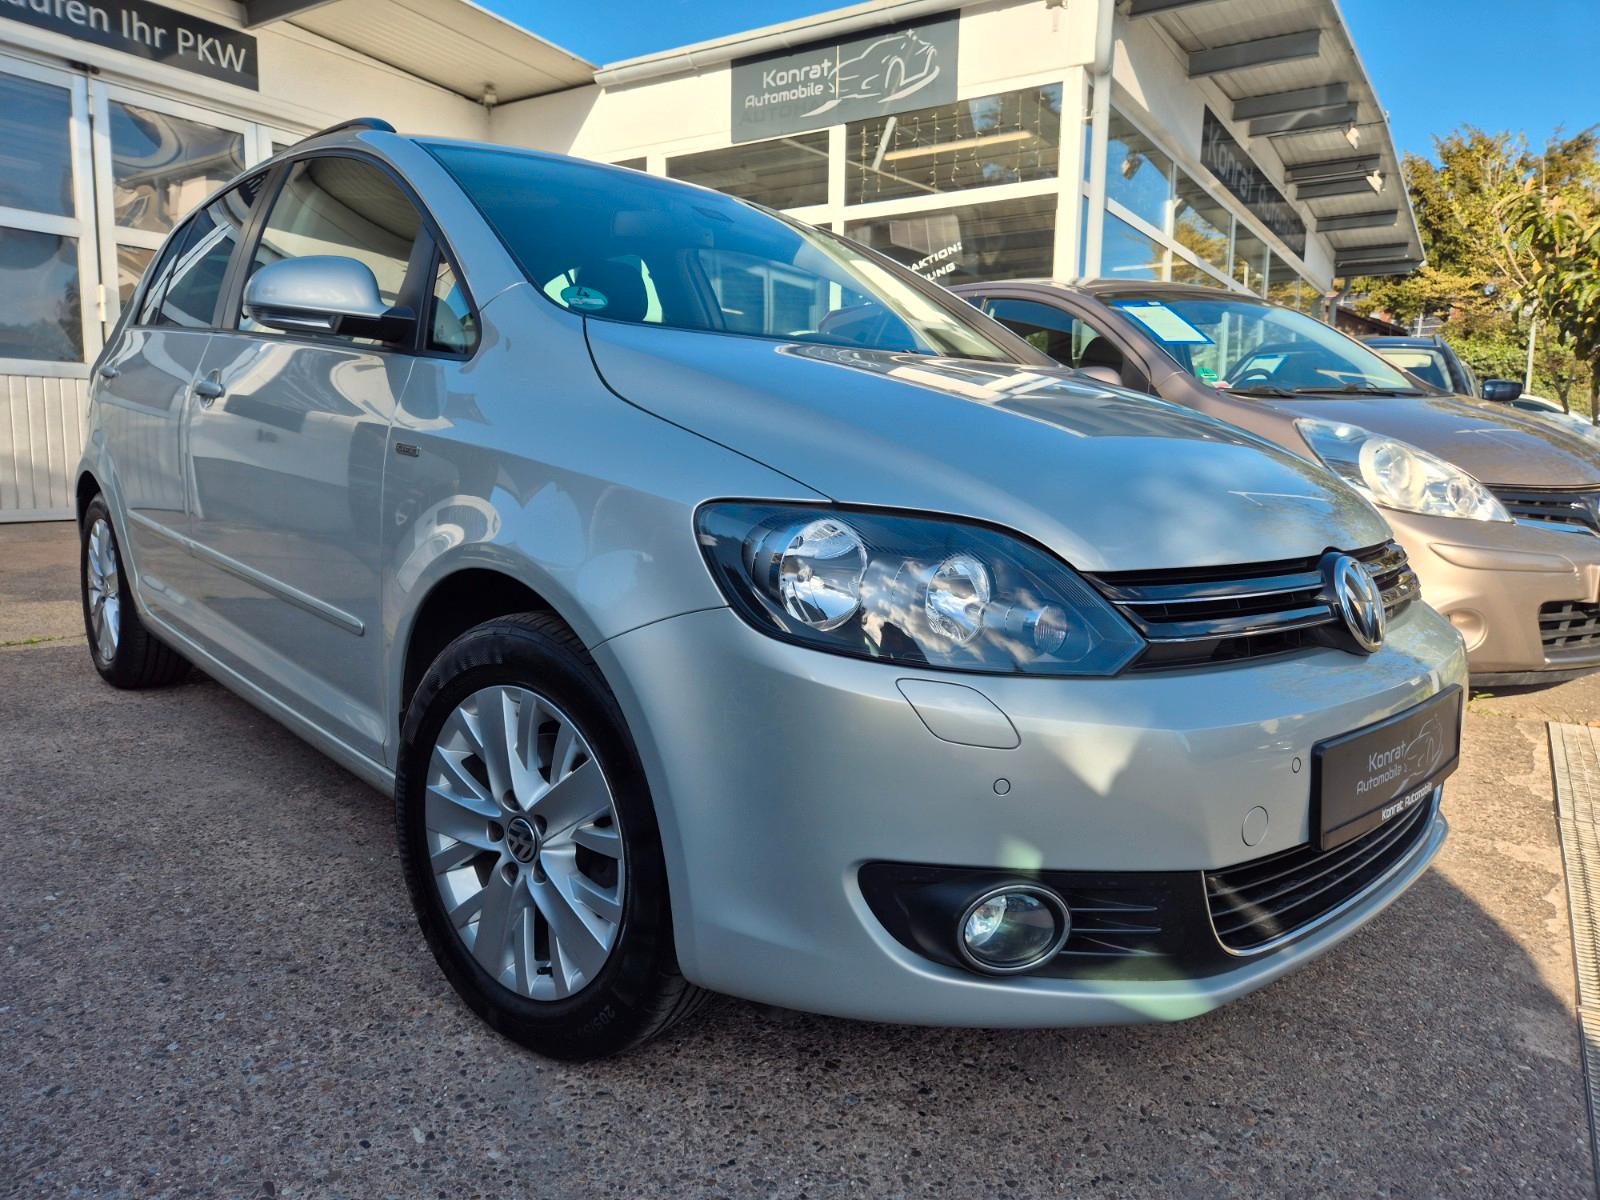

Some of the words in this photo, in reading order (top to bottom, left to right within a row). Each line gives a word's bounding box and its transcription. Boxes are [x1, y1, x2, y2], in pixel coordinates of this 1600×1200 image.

[121, 9, 168, 48] Ihr
[178, 27, 246, 73] PKW
[763, 59, 833, 89] Konrat
[745, 82, 824, 109] Automobile
[924, 262, 956, 281] UNG
[1369, 739, 1407, 773] Konrat
[1356, 763, 1402, 795] Automobile
